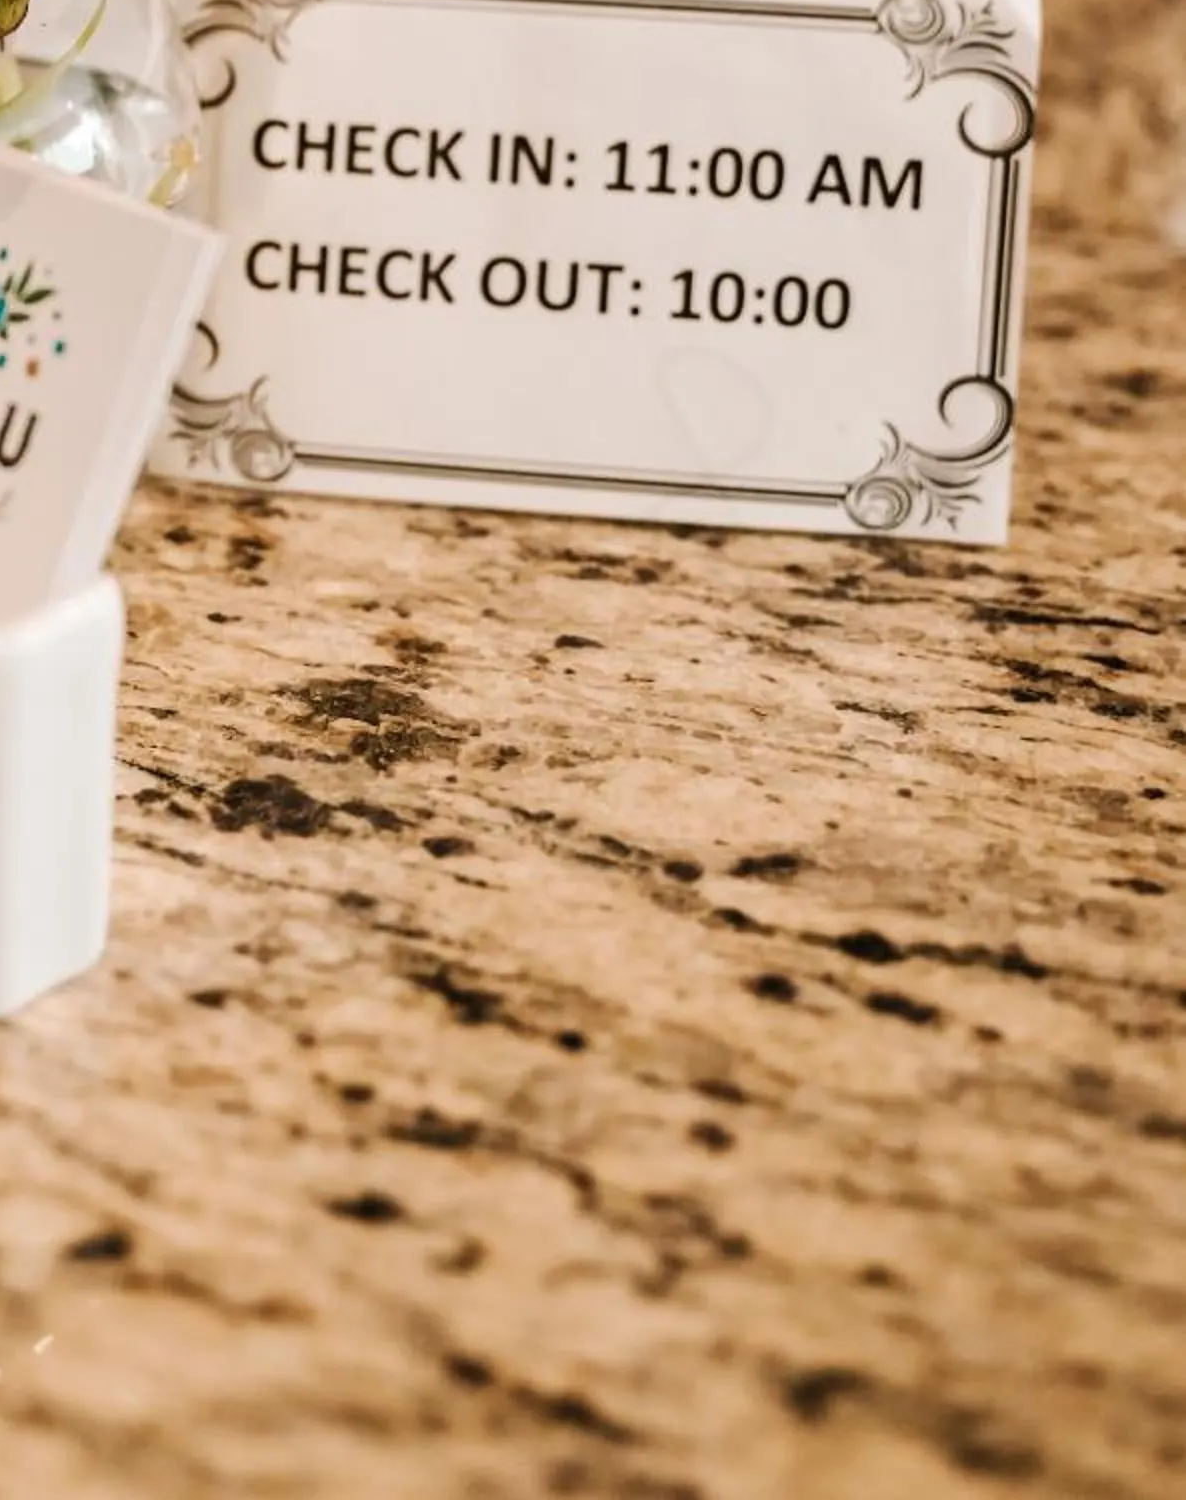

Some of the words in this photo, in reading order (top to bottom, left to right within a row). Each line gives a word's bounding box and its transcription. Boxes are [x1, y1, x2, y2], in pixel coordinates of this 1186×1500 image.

[252, 118, 464, 182] CHECK
[488, 132, 577, 187] IN:
[605, 140, 786, 201] 11:00
[805, 153, 923, 210] AM
[245, 240, 457, 304] CHECK
[480, 256, 643, 315] OUT:
[670, 269, 851, 330] 10:00
